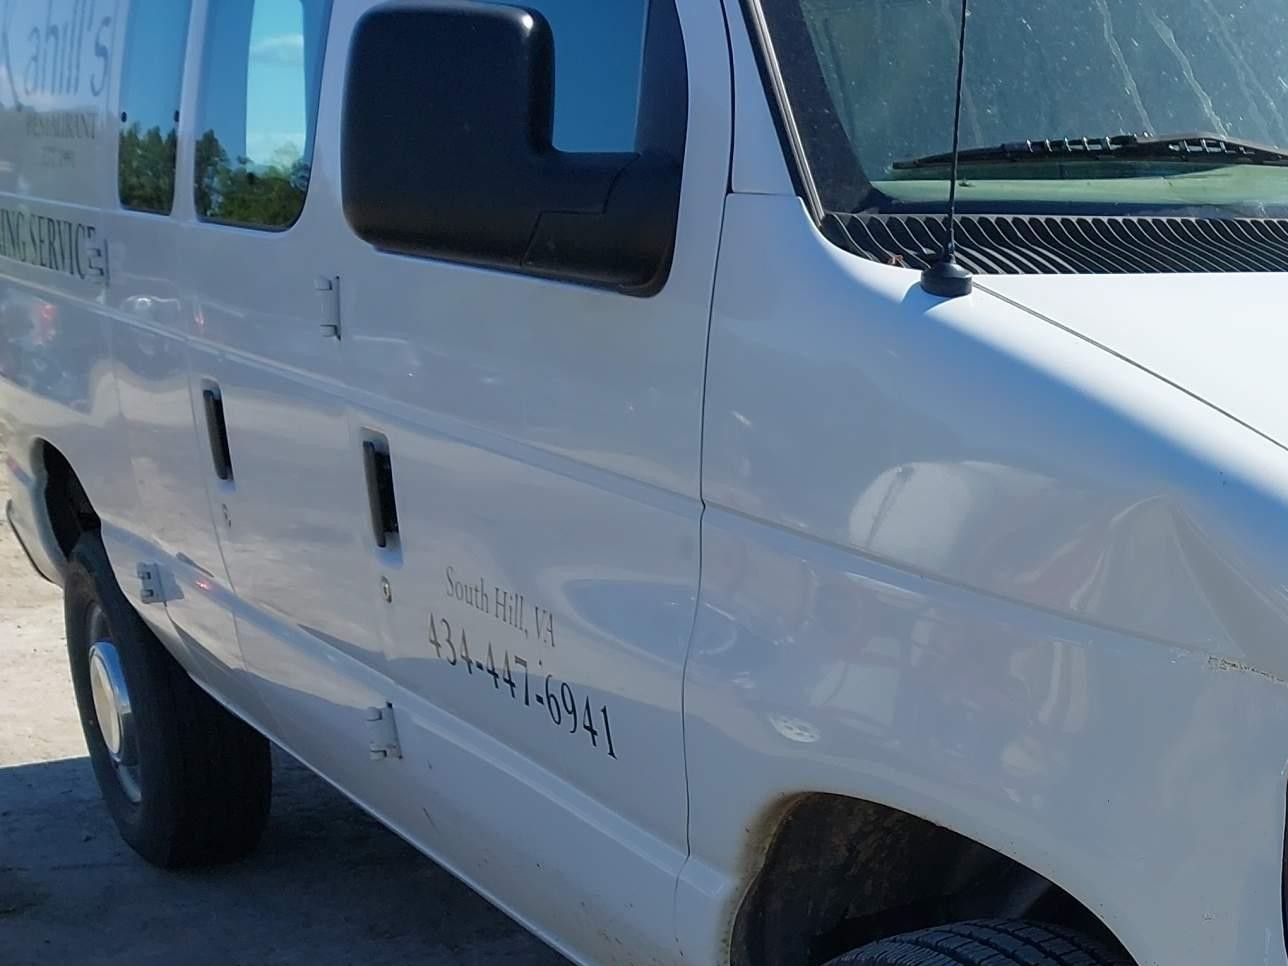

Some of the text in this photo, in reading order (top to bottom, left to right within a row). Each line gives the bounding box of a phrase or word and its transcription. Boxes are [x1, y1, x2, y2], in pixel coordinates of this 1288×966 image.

[0, 208, 27, 263] ING
[446, 566, 556, 648] South Hill, VA
[428, 611, 617, 761] 434-447-6941
